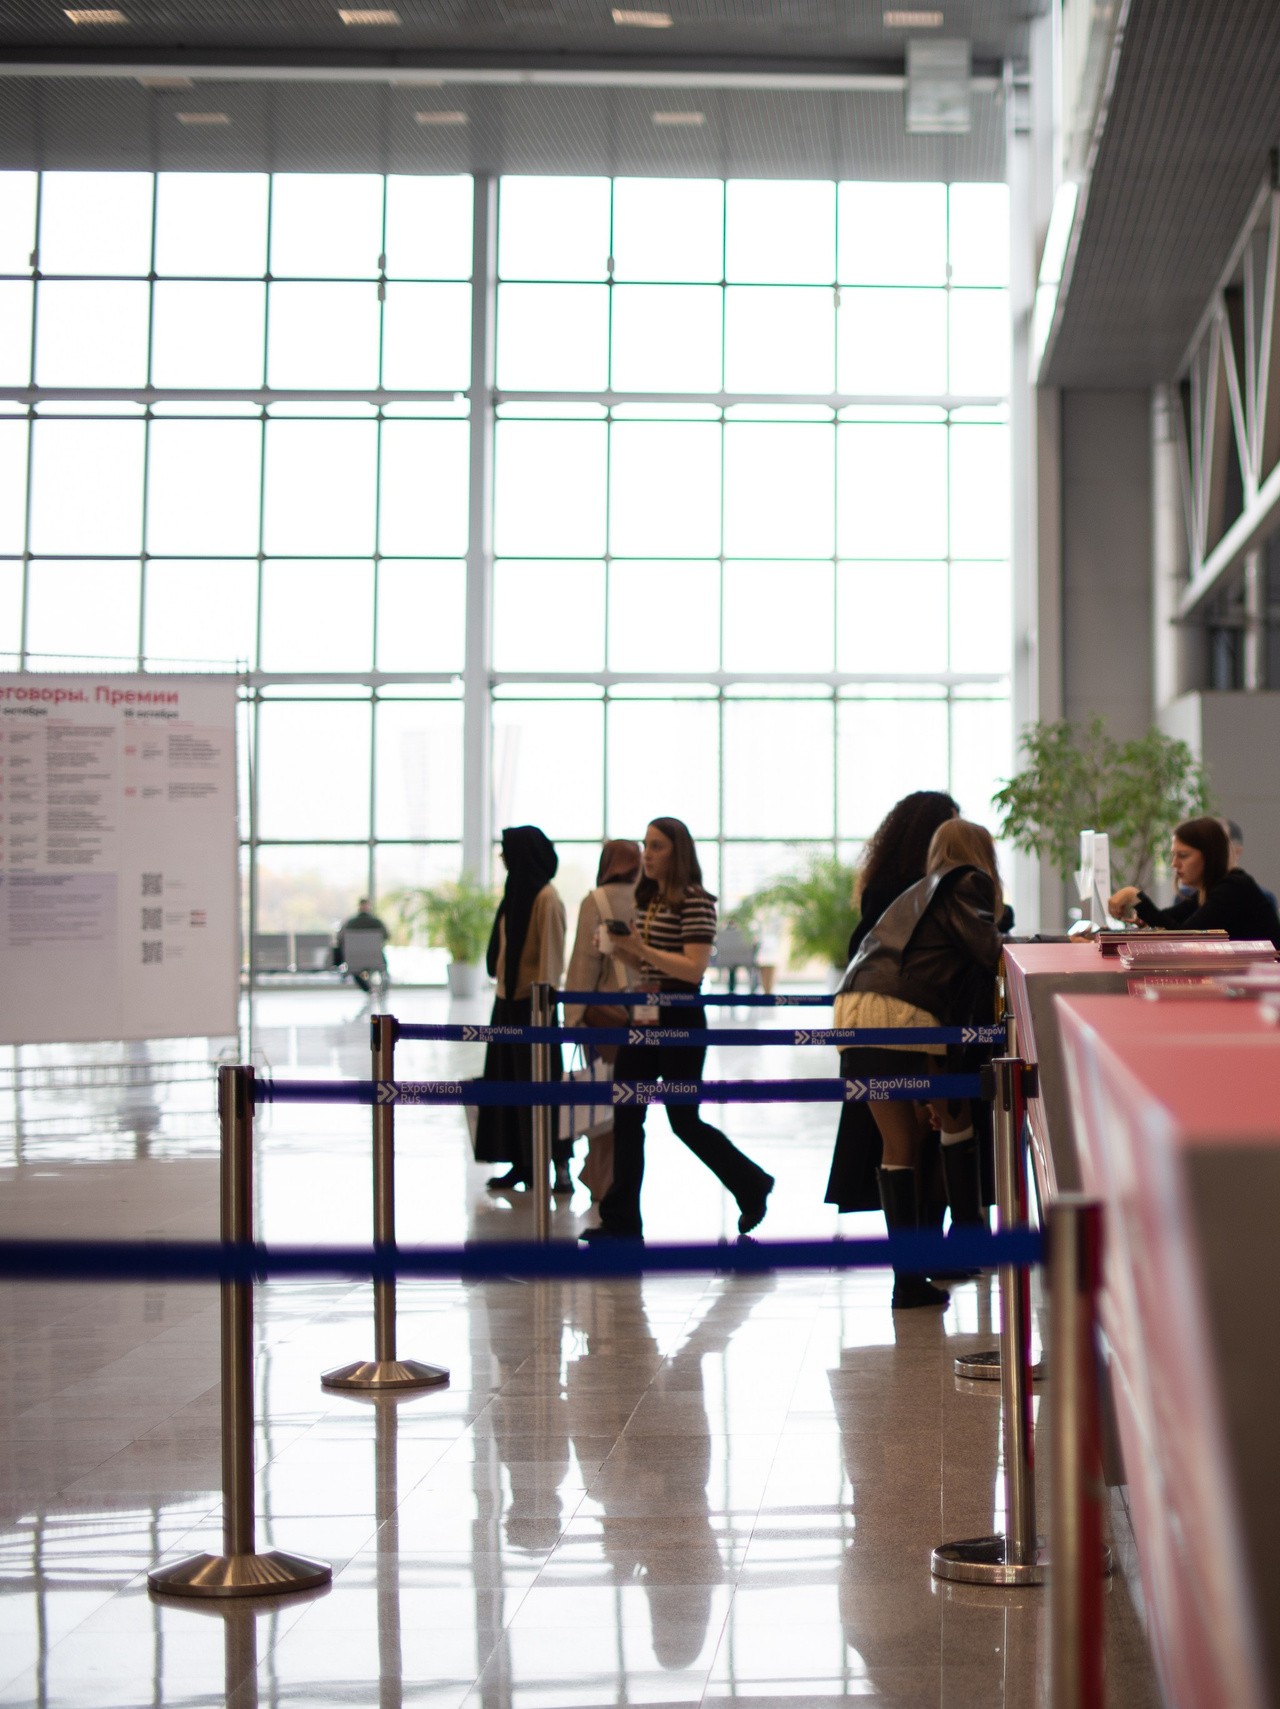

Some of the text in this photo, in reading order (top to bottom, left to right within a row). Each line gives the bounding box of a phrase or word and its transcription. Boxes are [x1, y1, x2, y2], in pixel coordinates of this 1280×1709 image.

[95, 685, 179, 707] Премии
[479, 1026, 523, 1036] ExpoVision
[645, 1029, 689, 1039] ExpoVision
[811, 1029, 855, 1038] ExpoVision
[479, 1034, 494, 1042] Rus
[645, 1037, 660, 1045] Rus
[811, 1037, 826, 1045] Rus
[978, 1034, 993, 1043] Rus
[401, 1083, 462, 1096] ExpoVision
[636, 1082, 697, 1095] ExpoVision
[869, 1078, 930, 1091] ExpoVision
[401, 1094, 421, 1104] Rus
[636, 1094, 656, 1104] Rus
[869, 1090, 890, 1100] Rus
